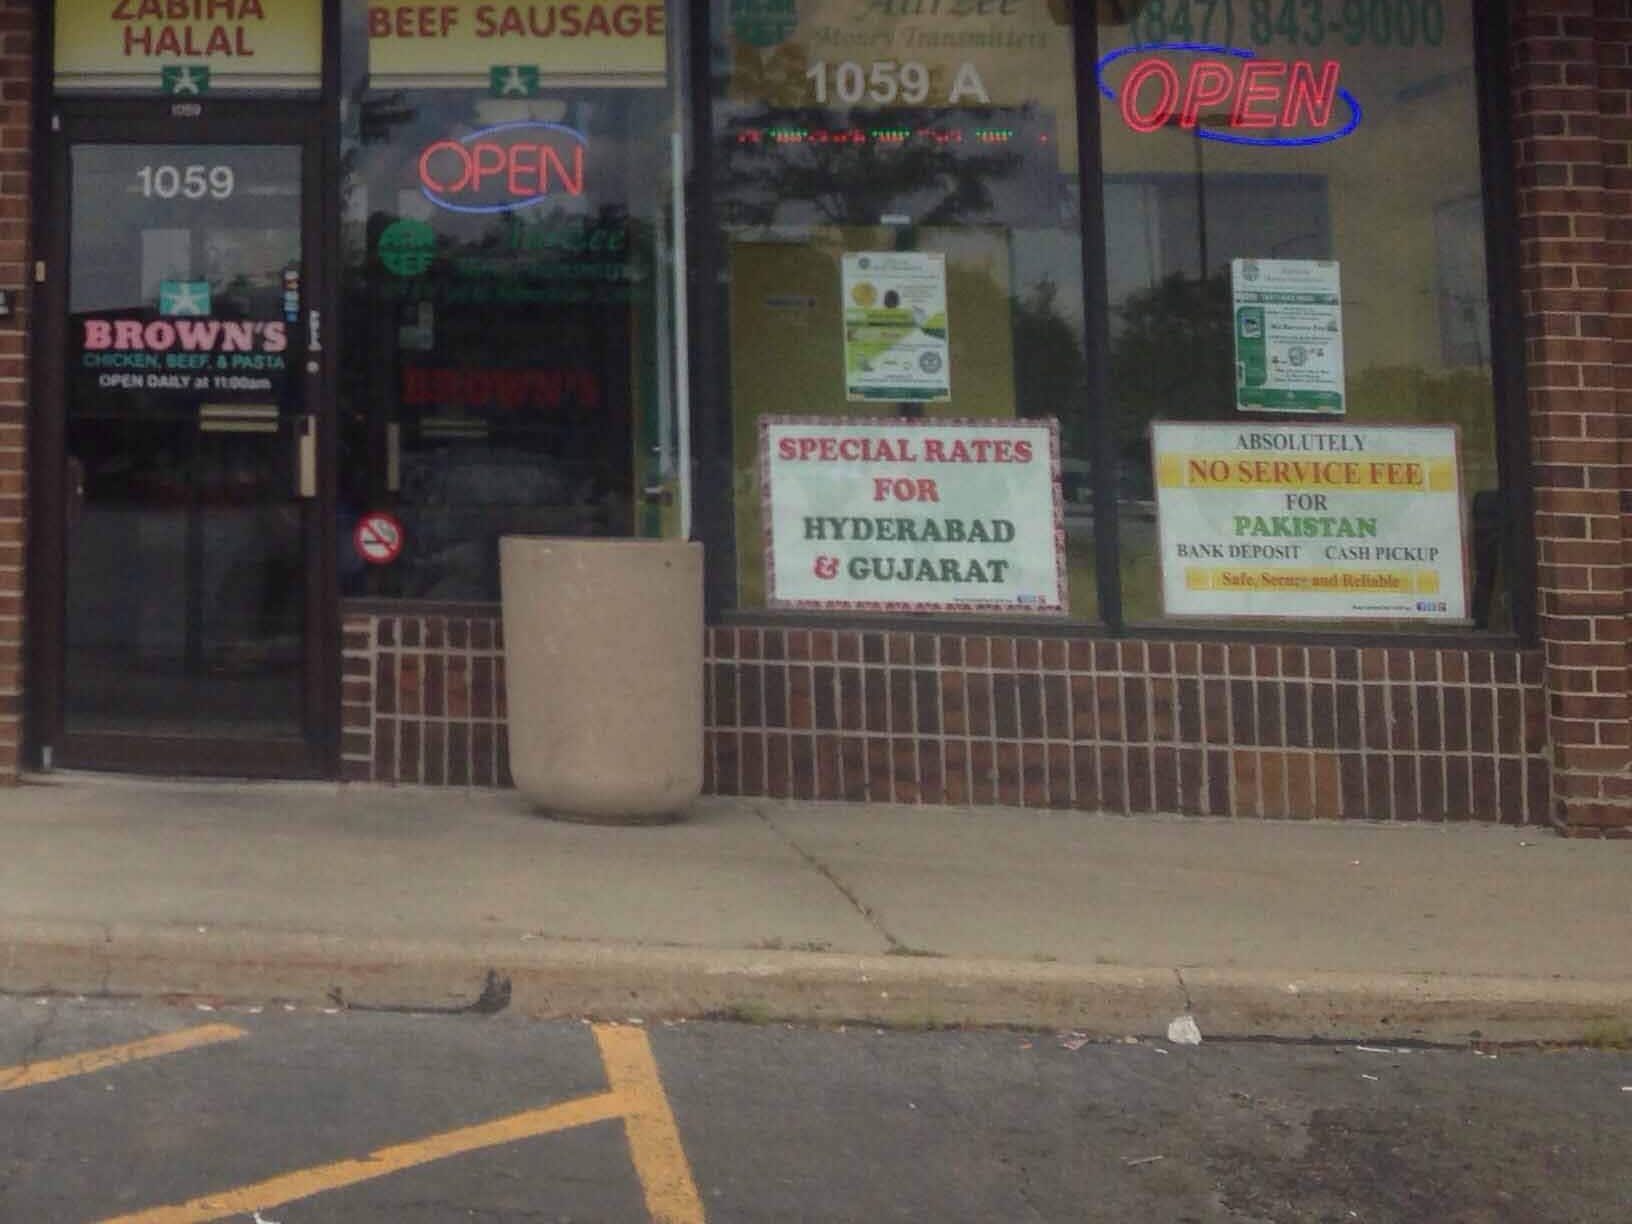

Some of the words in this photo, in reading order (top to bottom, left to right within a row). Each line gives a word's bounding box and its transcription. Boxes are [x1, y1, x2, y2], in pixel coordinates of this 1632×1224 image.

[369, 6, 458, 39] BEEF
[475, 5, 665, 38] SAUSAGE
[123, 24, 254, 57] HALAL
[806, 60, 930, 105] 1059
[949, 61, 991, 105] A
[1119, 57, 1341, 133] OPEN
[136, 164, 235, 199] 1059
[418, 138, 584, 197] OPEN
[83, 319, 287, 353] BROWN'S
[98, 373, 144, 389] OPEN
[147, 374, 189, 389] DAILY
[778, 437, 918, 462] SPECIAL
[924, 439, 1034, 463] RATES
[1235, 432, 1366, 452] ABSOLUTELY
[1187, 458, 1230, 484] NO
[1238, 460, 1362, 485] SERVICE
[1369, 462, 1425, 486] FEE
[872, 477, 941, 503] FOR
[1284, 493, 1329, 511] FOR
[802, 516, 1016, 544] HYDERABAD
[1233, 514, 1378, 539] PAKISTAN
[1177, 543, 1224, 559] BANK
[1228, 544, 1302, 560] DEPOSIT
[1325, 544, 1371, 561] CASH
[1375, 545, 1440, 562] PICKUP
[813, 554, 841, 581] &
[847, 556, 1009, 584] GUJARAT
